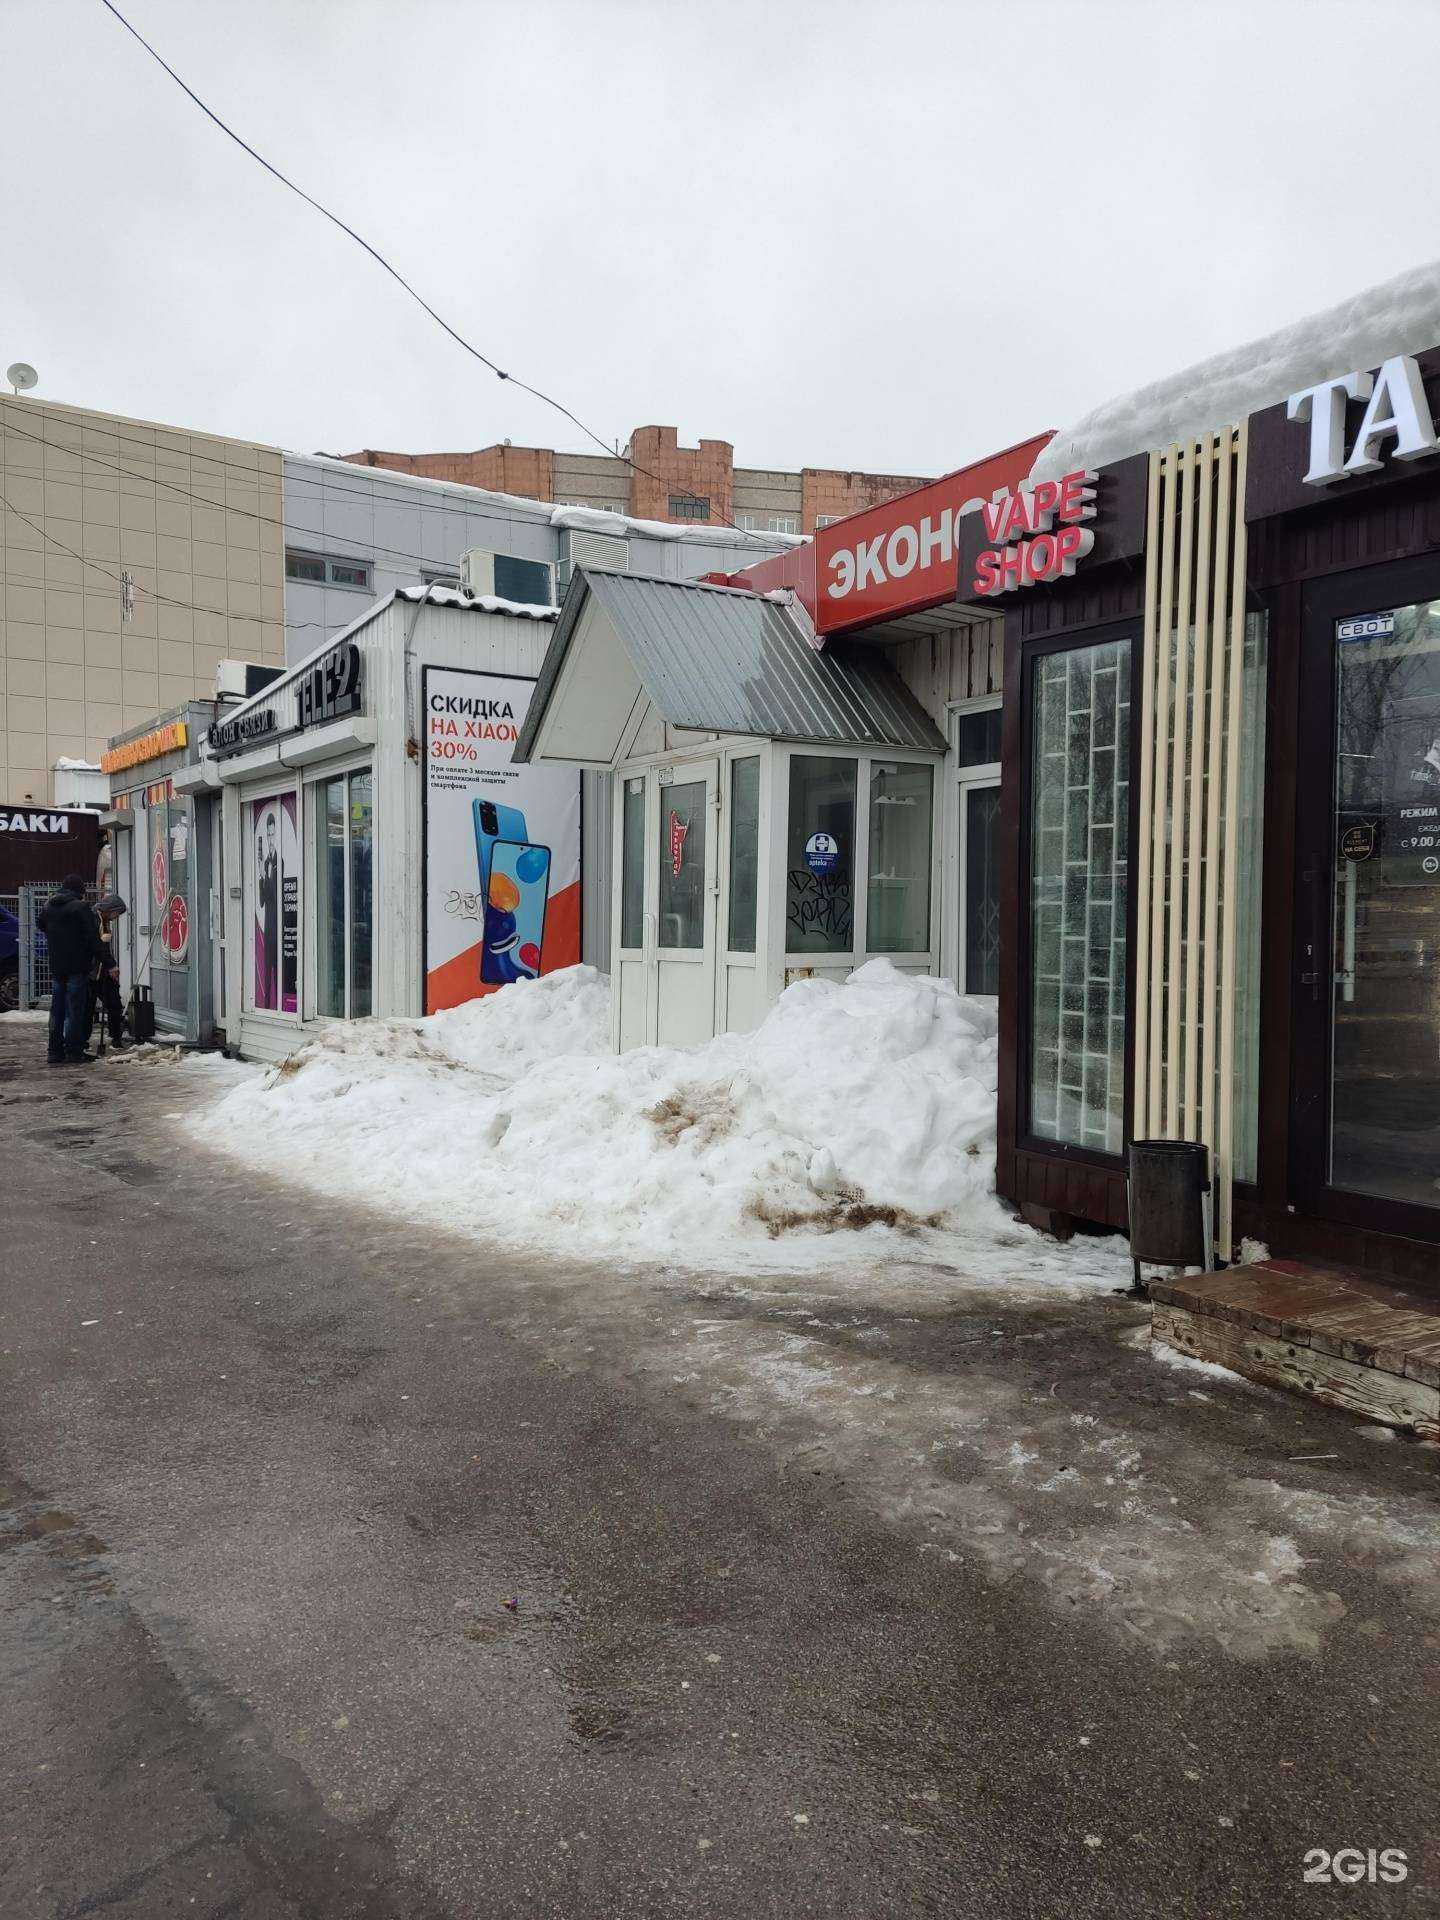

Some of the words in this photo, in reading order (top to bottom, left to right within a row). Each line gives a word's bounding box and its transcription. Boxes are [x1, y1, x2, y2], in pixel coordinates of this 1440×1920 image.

[982, 469, 1099, 544] VAPE
[973, 526, 1094, 596] SHOP
[431, 694, 514, 720] СКИДКА
[431, 718, 458, 737] НА
[431, 741, 478, 760] 30%
[1400, 807, 1438, 819] РЕЖИМ
[1411, 836, 1434, 847] 9.00
